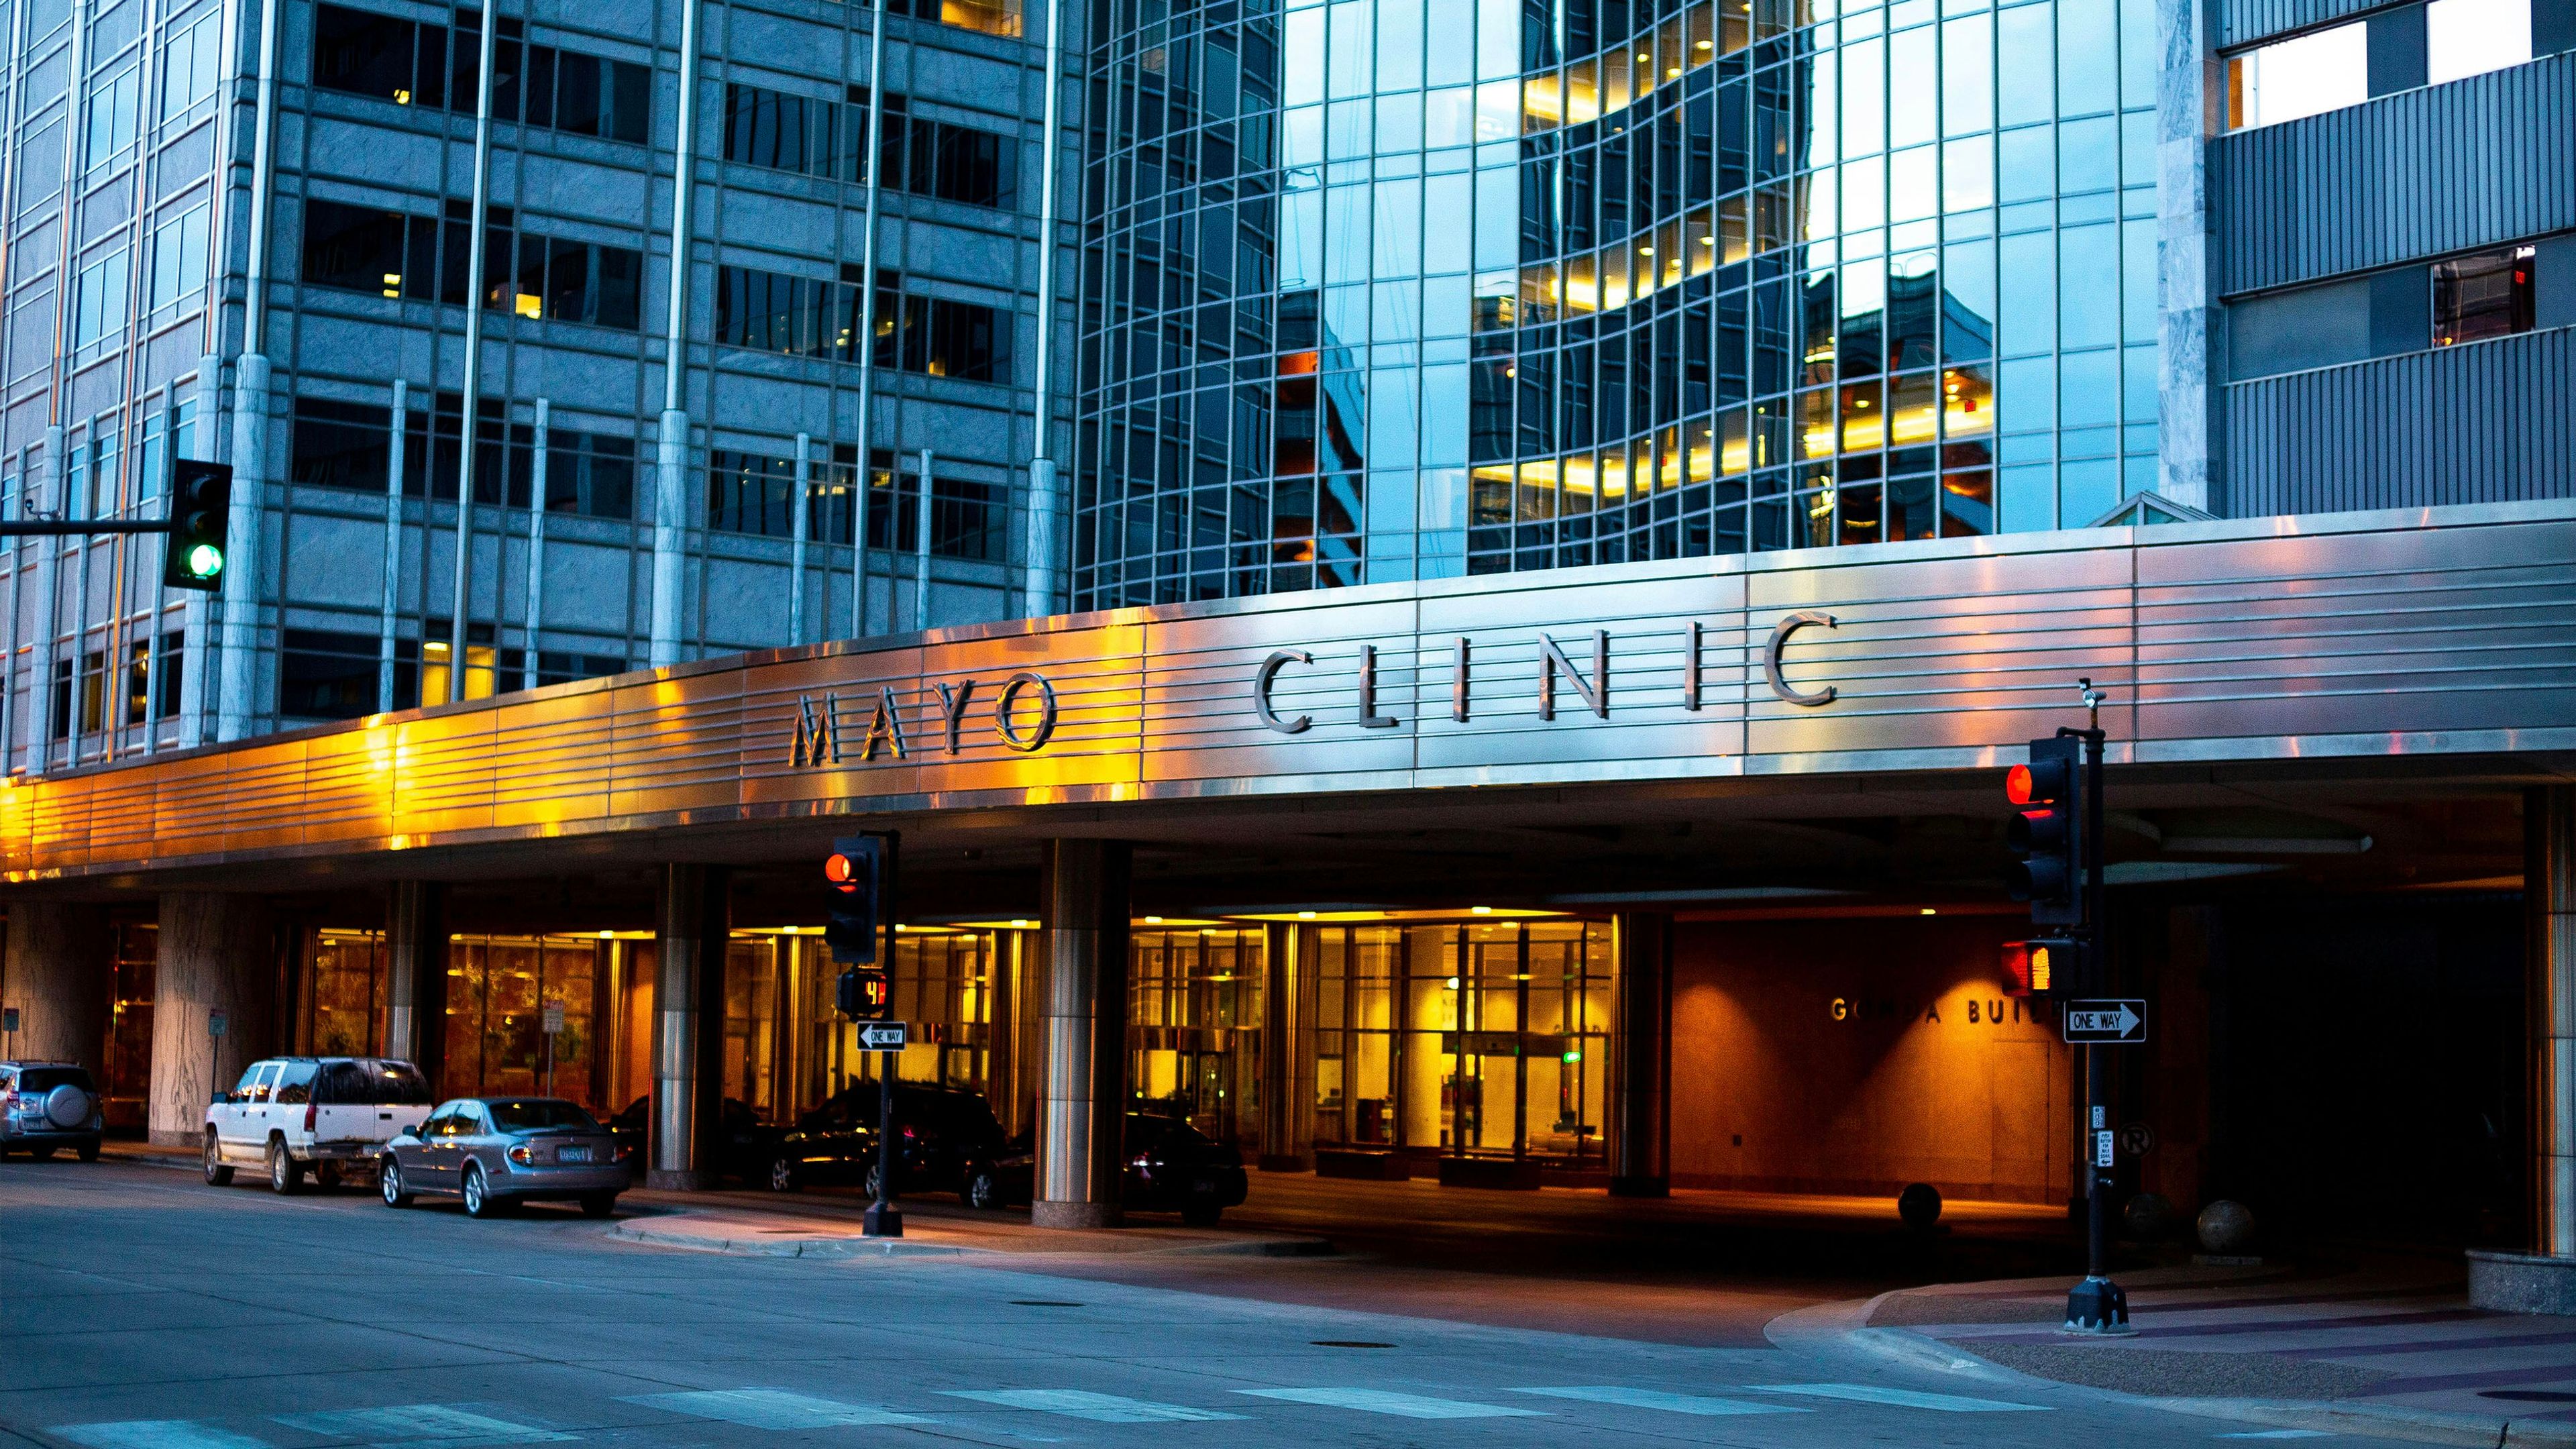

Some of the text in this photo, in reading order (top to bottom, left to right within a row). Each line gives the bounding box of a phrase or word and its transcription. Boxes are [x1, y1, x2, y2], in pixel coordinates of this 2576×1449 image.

[788, 610, 1837, 767] MAYO CLINIC
[2074, 1013, 2122, 1029] ONE WAY
[871, 1031, 900, 1042] ONE WAY
